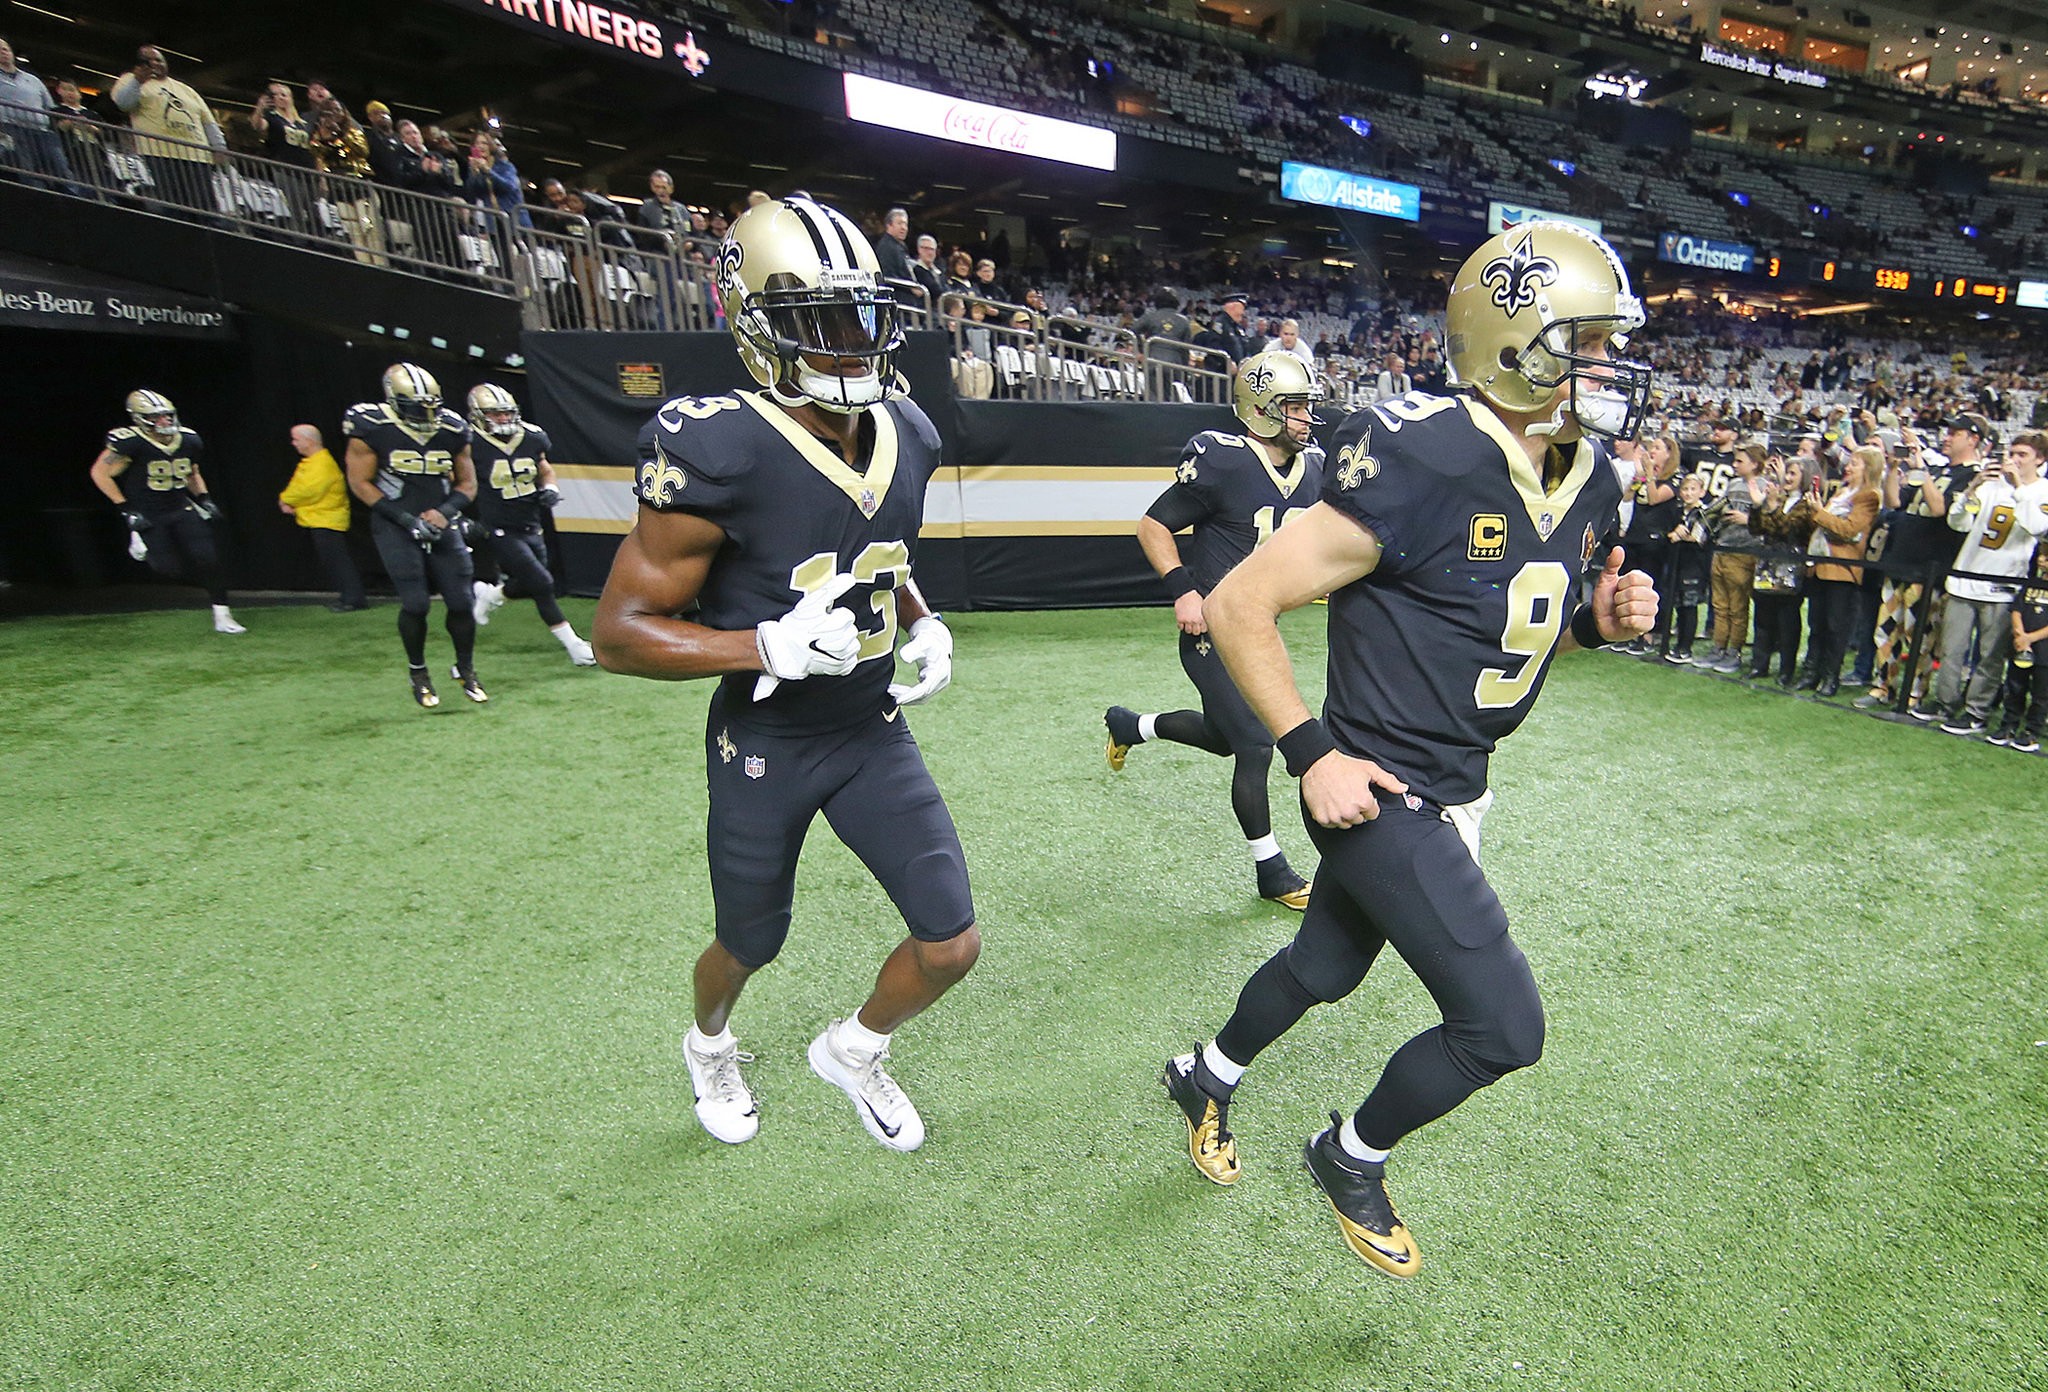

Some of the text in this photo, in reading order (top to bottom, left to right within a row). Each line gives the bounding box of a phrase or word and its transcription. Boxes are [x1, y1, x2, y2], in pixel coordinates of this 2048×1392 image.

[1700, 44, 1827, 88] Mercedes-Benz Superdome
[1331, 180, 1403, 214] Allstate
[1676, 236, 1748, 272] Ochsner
[106, 297, 223, 326] Superdome
[489, 457, 538, 500] 42
[1696, 460, 1736, 500] 56
[1473, 517, 1504, 549] C
[1979, 505, 2015, 550] 9
[1473, 561, 1571, 710] 9
